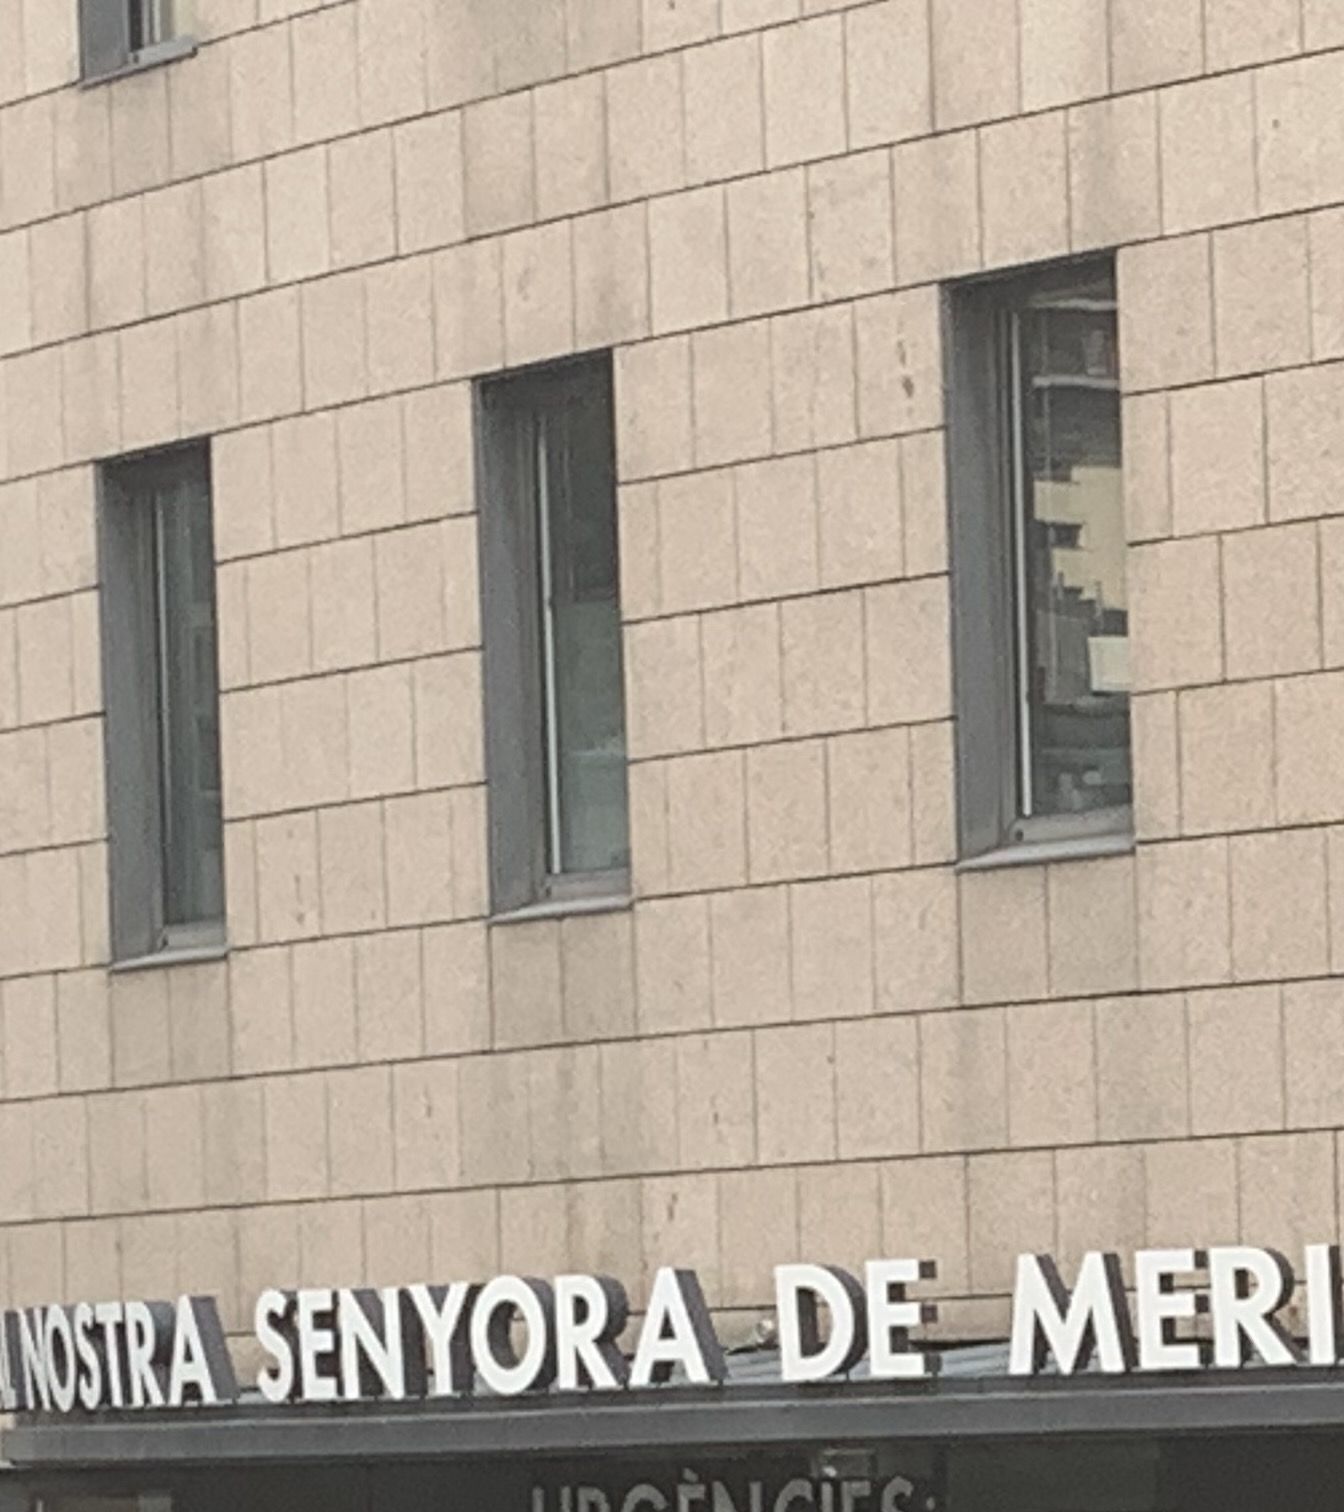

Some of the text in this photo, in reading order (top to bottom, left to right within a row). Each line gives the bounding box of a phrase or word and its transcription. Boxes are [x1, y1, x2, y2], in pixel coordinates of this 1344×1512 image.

[18, 1294, 219, 1412] NOSTRA
[255, 1266, 713, 1403] SENYORA
[775, 1257, 928, 1383] DE
